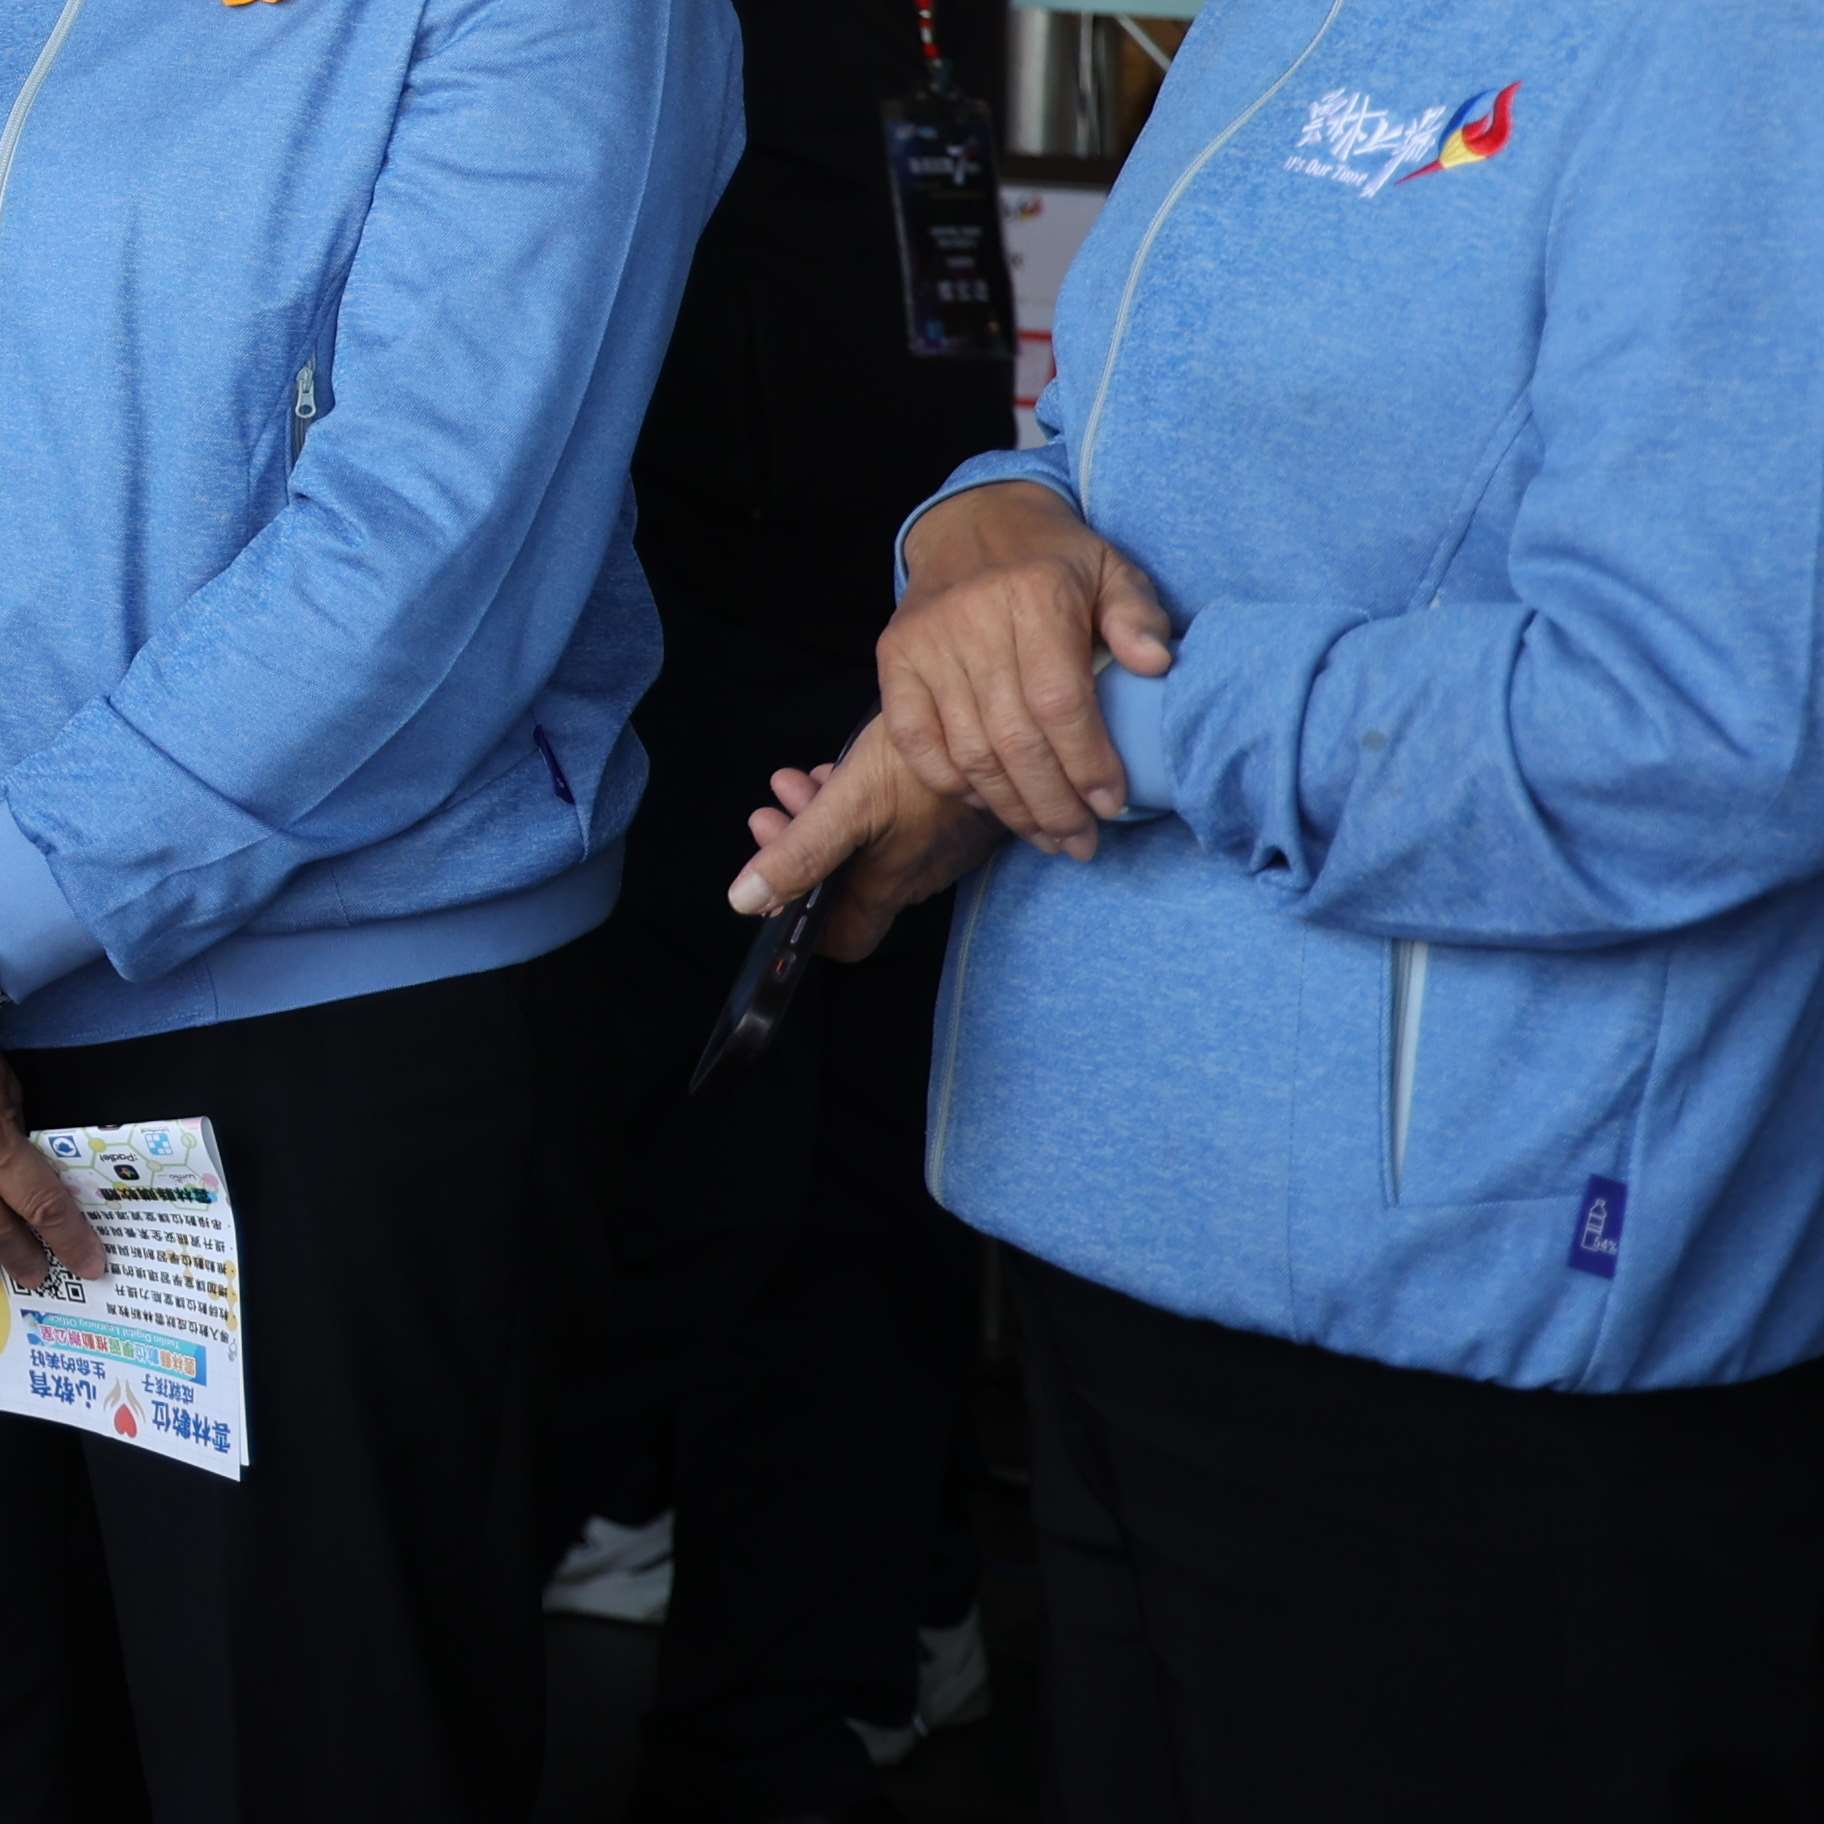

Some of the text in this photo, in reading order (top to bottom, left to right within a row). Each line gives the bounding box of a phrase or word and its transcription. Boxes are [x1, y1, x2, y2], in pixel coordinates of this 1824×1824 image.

[1304, 158, 1331, 177] Our
[104, 1263, 228, 1298] 增加課堂學習環境的豐
[31, 1348, 106, 1380] 生命的美好
[29, 1369, 97, 1409] 心教育
[141, 1374, 194, 1405] 成就孩子
[151, 1399, 231, 1454] 雲林數位
